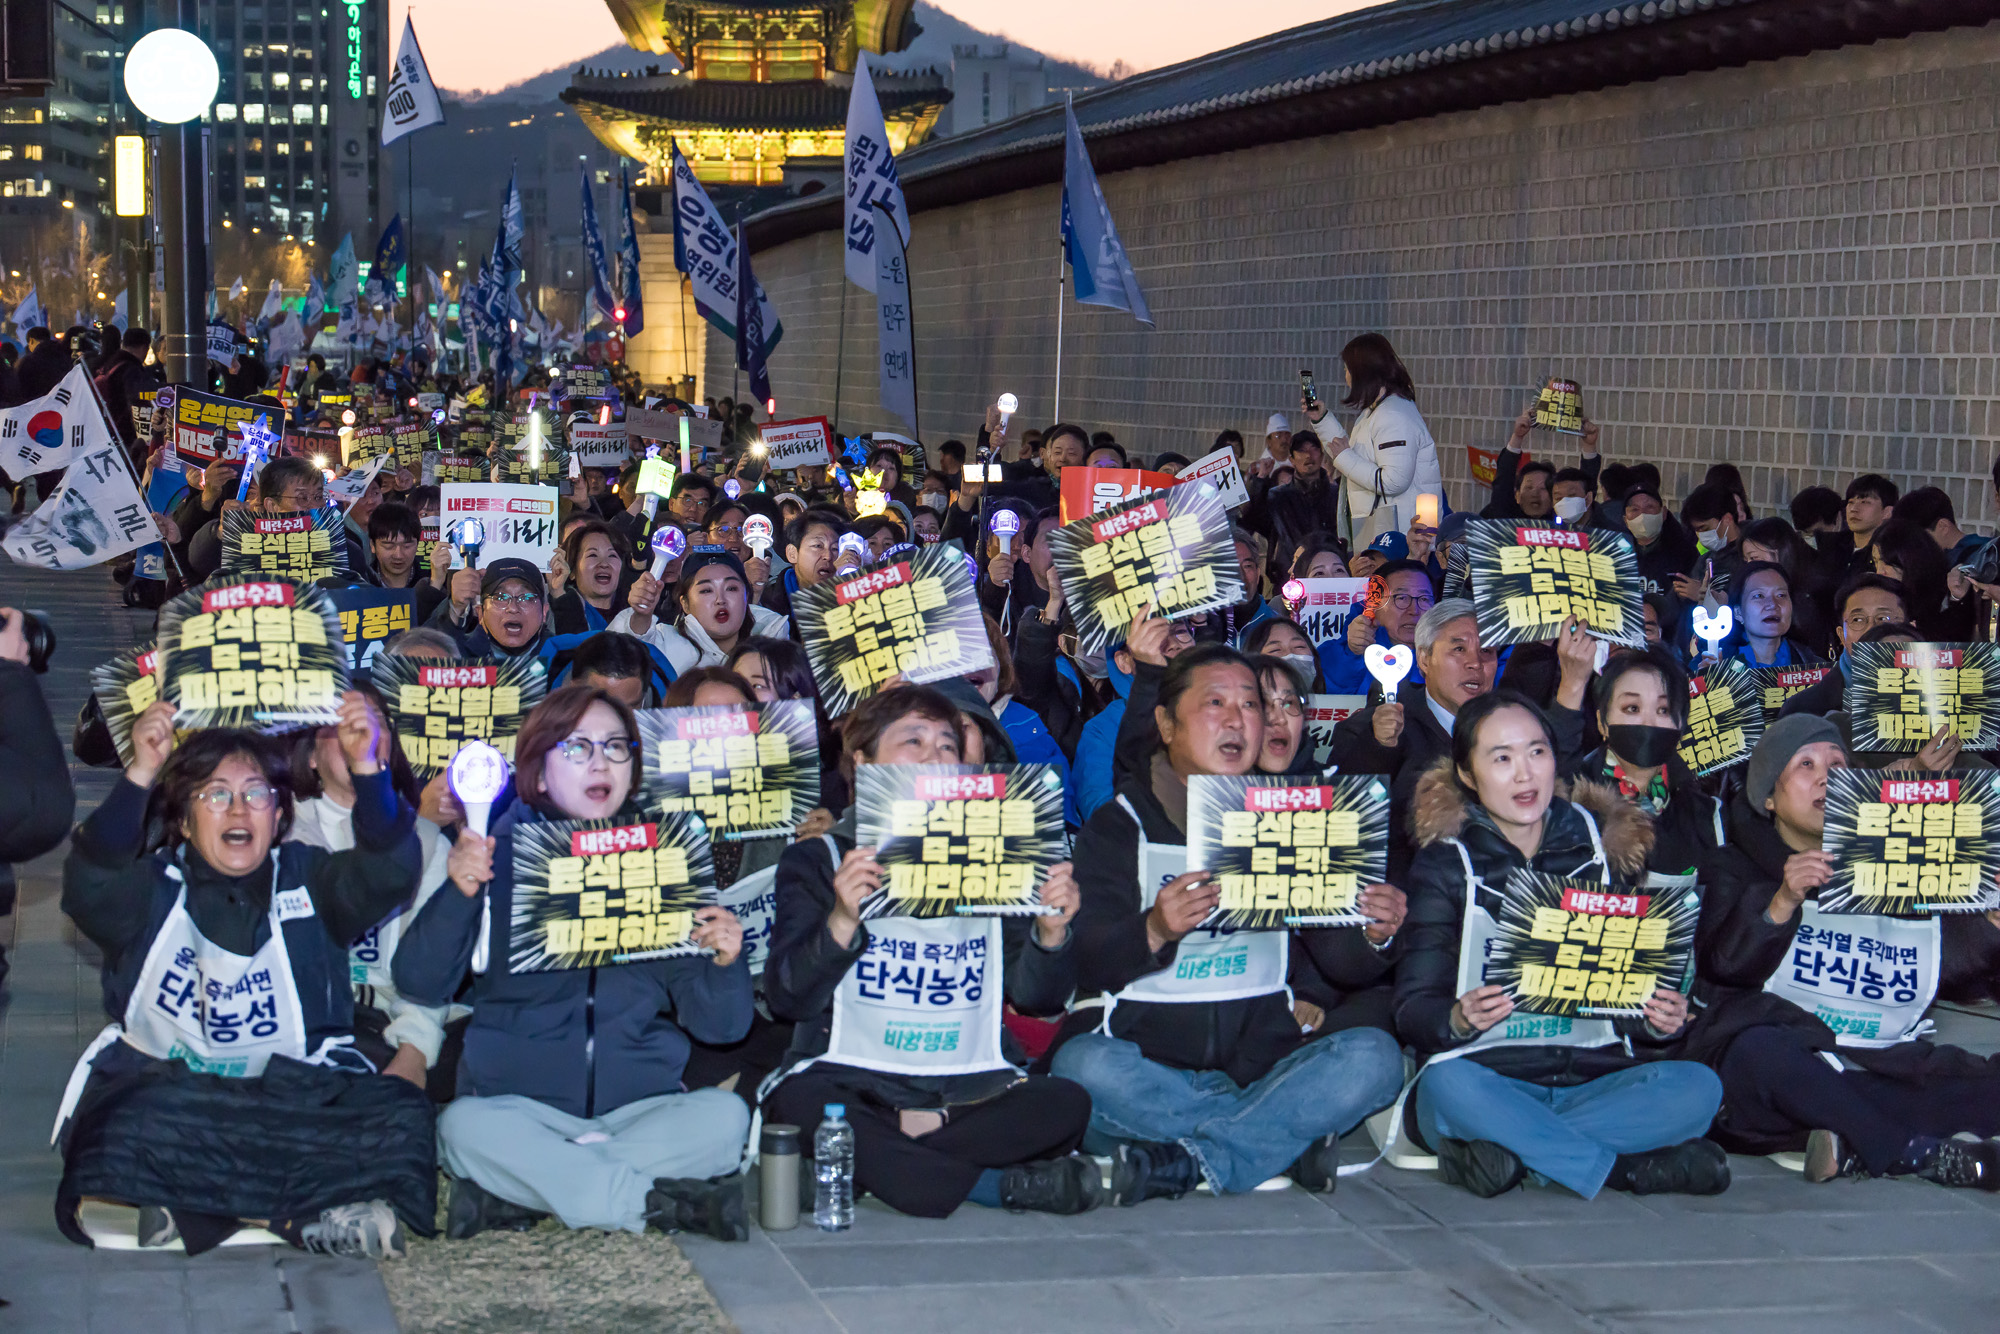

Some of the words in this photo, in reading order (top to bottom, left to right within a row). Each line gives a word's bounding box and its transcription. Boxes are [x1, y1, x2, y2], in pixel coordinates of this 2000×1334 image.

[347, 25, 361, 98] 하나은행
[883, 300, 905, 332] 민주
[884, 350, 908, 379] 연대
[248, 427, 271, 442] 윤석열
[250, 438, 265, 449] 파면
[447, 498, 505, 512] 내란동조
[511, 500, 551, 514] 국민의힘
[1099, 503, 1158, 537] 내란수괴
[260, 518, 304, 532] 내란수괴
[445, 518, 555, 547] 하라!
[1379, 532, 1393, 547] LA
[1524, 529, 1581, 547] 내란수괴
[241, 529, 331, 554] 윤석열을
[1081, 513, 1204, 580] 윤석열을
[260, 552, 313, 569] 즉-각!
[1113, 550, 1185, 590] 즉-각!
[1500, 546, 1616, 583] 윤석열을
[211, 584, 284, 607] 내란수괴
[842, 566, 902, 599] 내란수괴
[1096, 565, 1217, 630] 파면하라
[1530, 573, 1598, 599] 즉-각!
[362, 604, 410, 639] 종식
[824, 576, 948, 642] 윤석열을
[1505, 593, 1624, 632] 파면하라
[181, 606, 328, 650] 윤석열을
[854, 612, 926, 653] 즉-각!
[211, 642, 300, 669] 즉-각!
[839, 629, 961, 693] 파면하라
[179, 668, 336, 708] 파면하라
[427, 667, 486, 685] 내란수괴
[1782, 670, 1823, 686] 내란수괴
[1877, 668, 1984, 694] 윤석열을
[399, 684, 521, 716] 윤석열을
[1901, 694, 1961, 713] 즉-각!
[425, 716, 494, 737] 즉-각!
[686, 713, 749, 735] 내란수괴
[659, 733, 790, 774] 윤석열을
[1677, 726, 1746, 770] 면하라
[689, 767, 763, 795] 즉-각!
[925, 776, 994, 797] 내란수괴
[1890, 781, 1949, 801] 내란수괴
[1254, 788, 1322, 809] 내란수괴
[892, 800, 1035, 836] 윤석열을
[1221, 811, 1360, 847] 윤석열을
[1857, 803, 1983, 837] 윤석열을
[580, 826, 647, 852] 내란수괴
[922, 836, 1004, 863] 즉-각!
[1884, 837, 1957, 862] 즉-각!
[549, 847, 689, 894] 윤석열을
[1252, 847, 1330, 874] 즉-각!
[888, 863, 1034, 898] 파면하라
[1219, 873, 1358, 910] 파면하라
[1852, 862, 1981, 896] 파면하라
[579, 886, 662, 917] 즉-각!
[1571, 892, 1638, 914] 내란수괴
[545, 910, 693, 954] 파면하라
[1531, 906, 1671, 950] 윤석열을
[867, 935, 916, 962] 윤석열
[923, 936, 986, 964] 즉각파면
[1555, 944, 1635, 972] 즉-각!
[1797, 925, 1852, 953] 윤석열
[1857, 936, 1917, 965] 즉각파면
[1176, 953, 1248, 980] 비상행동
[1793, 949, 1918, 1003] 단식농성
[855, 961, 984, 1006] 단식농성
[1518, 963, 1657, 1004] 파면하라
[156, 970, 279, 1043] 단농성
[884, 1028, 960, 1052] 비상행동
